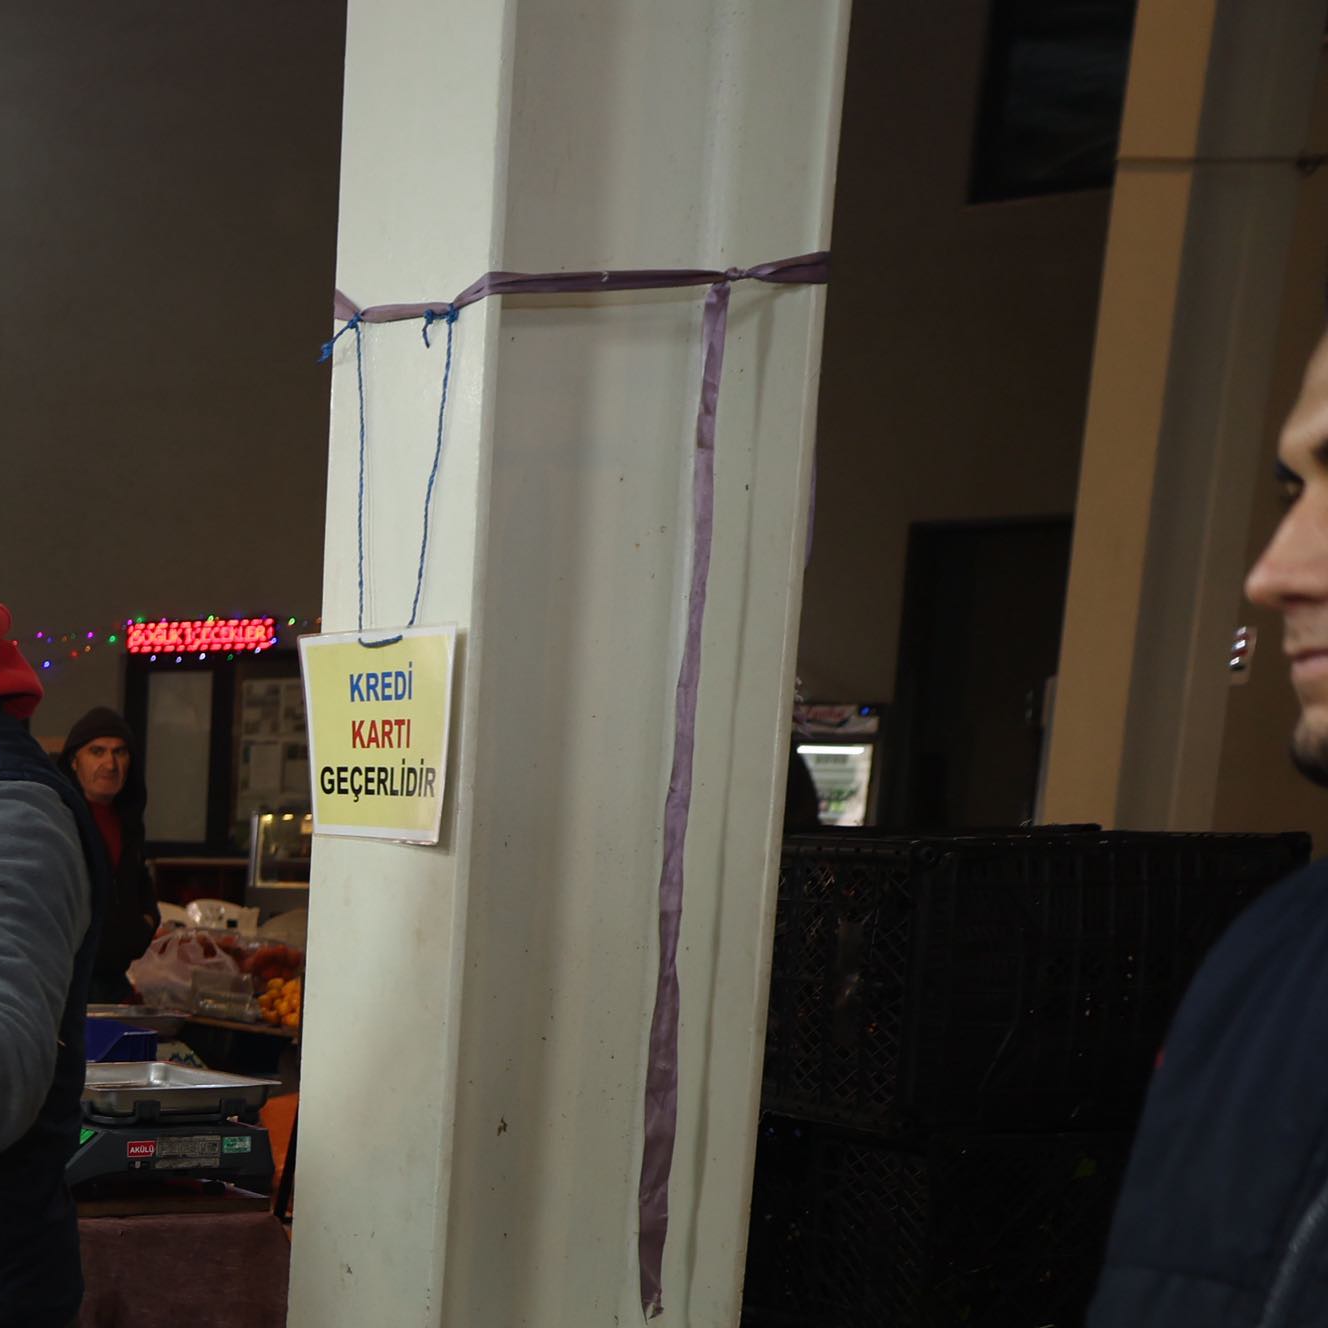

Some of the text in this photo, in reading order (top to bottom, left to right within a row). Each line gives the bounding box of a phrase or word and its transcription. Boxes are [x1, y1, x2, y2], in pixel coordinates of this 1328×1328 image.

[349, 661, 412, 702] KREDİ
[352, 719, 411, 749] KARTI
[320, 758, 436, 802] GEÇERLİDİR
[130, 1144, 155, 1154] AKÜLÜ
